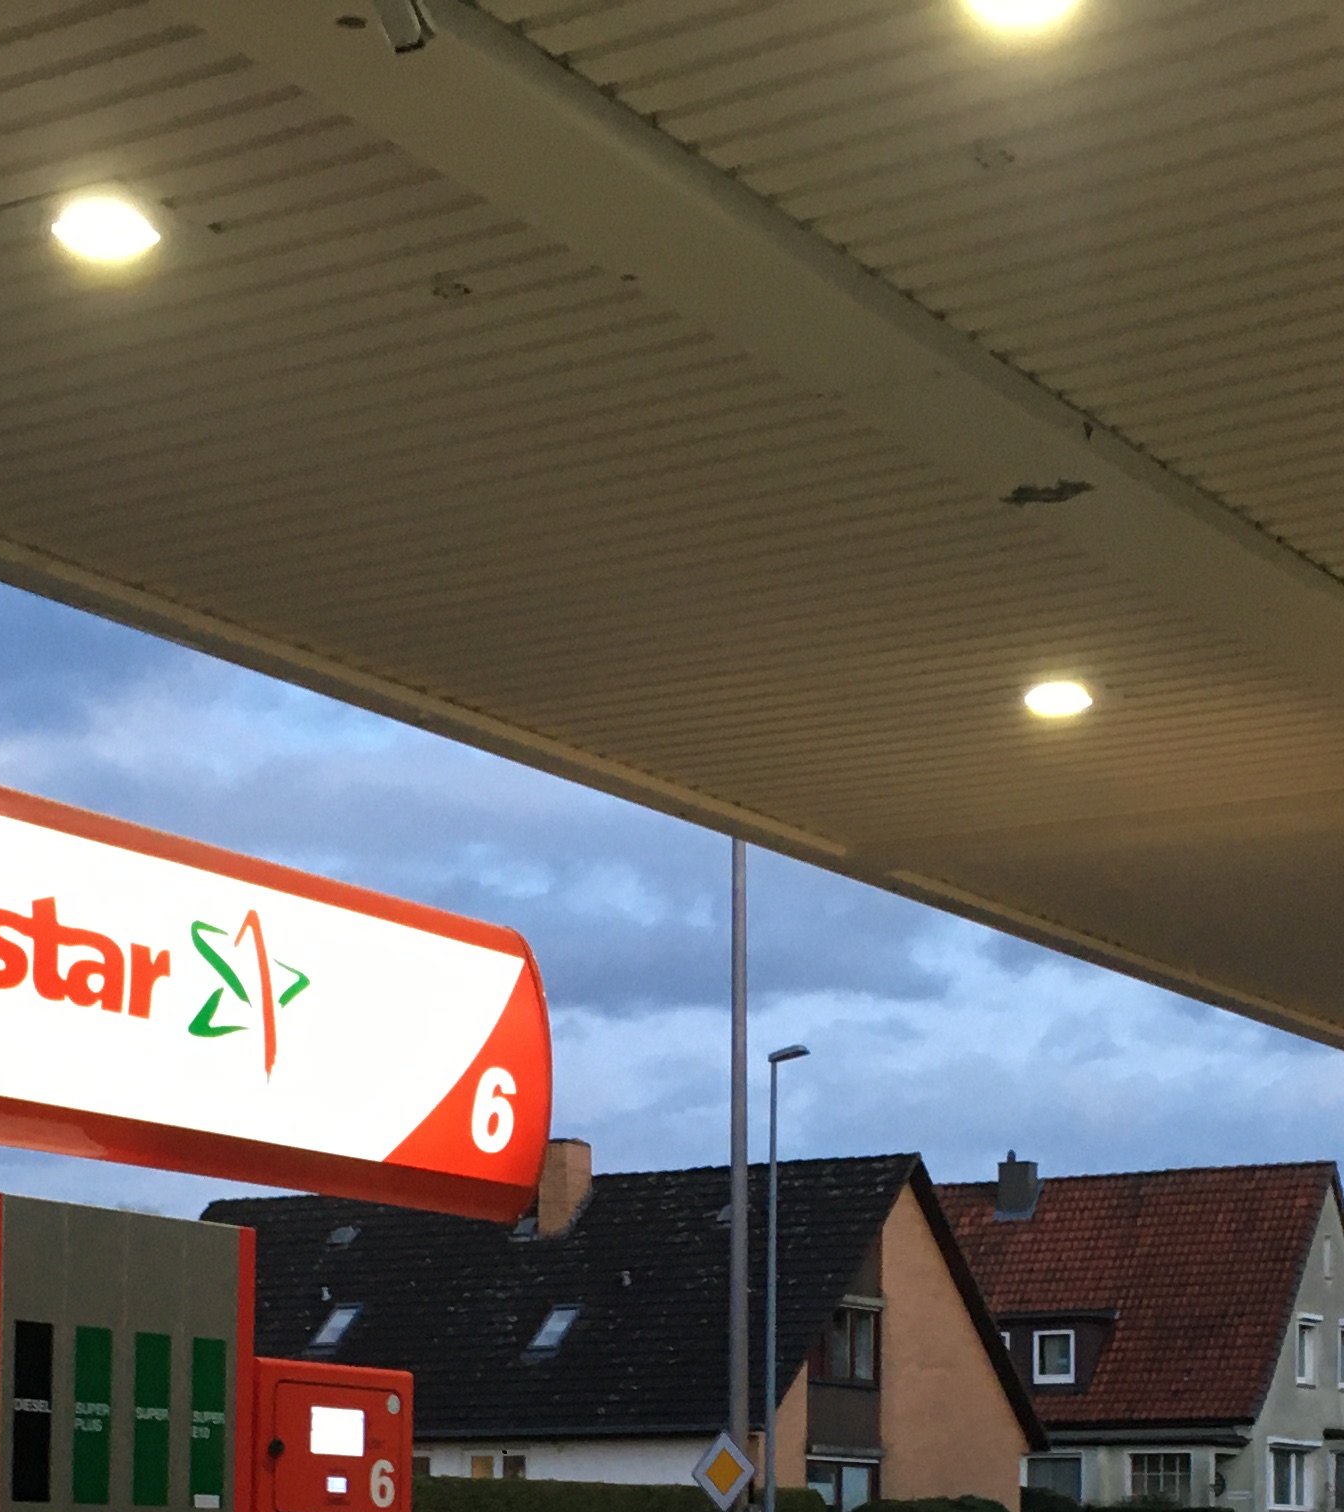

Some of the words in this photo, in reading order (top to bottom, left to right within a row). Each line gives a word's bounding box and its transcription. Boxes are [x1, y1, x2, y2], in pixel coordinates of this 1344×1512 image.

[471, 1066, 516, 1154] 6
[14, 1398, 52, 1413] DIESEL
[76, 1402, 110, 1416] SUPER
[136, 1407, 169, 1421] SUPER
[193, 1411, 226, 1425] SUPER
[75, 1418, 104, 1432] PLUS
[370, 1459, 396, 1508] 6
